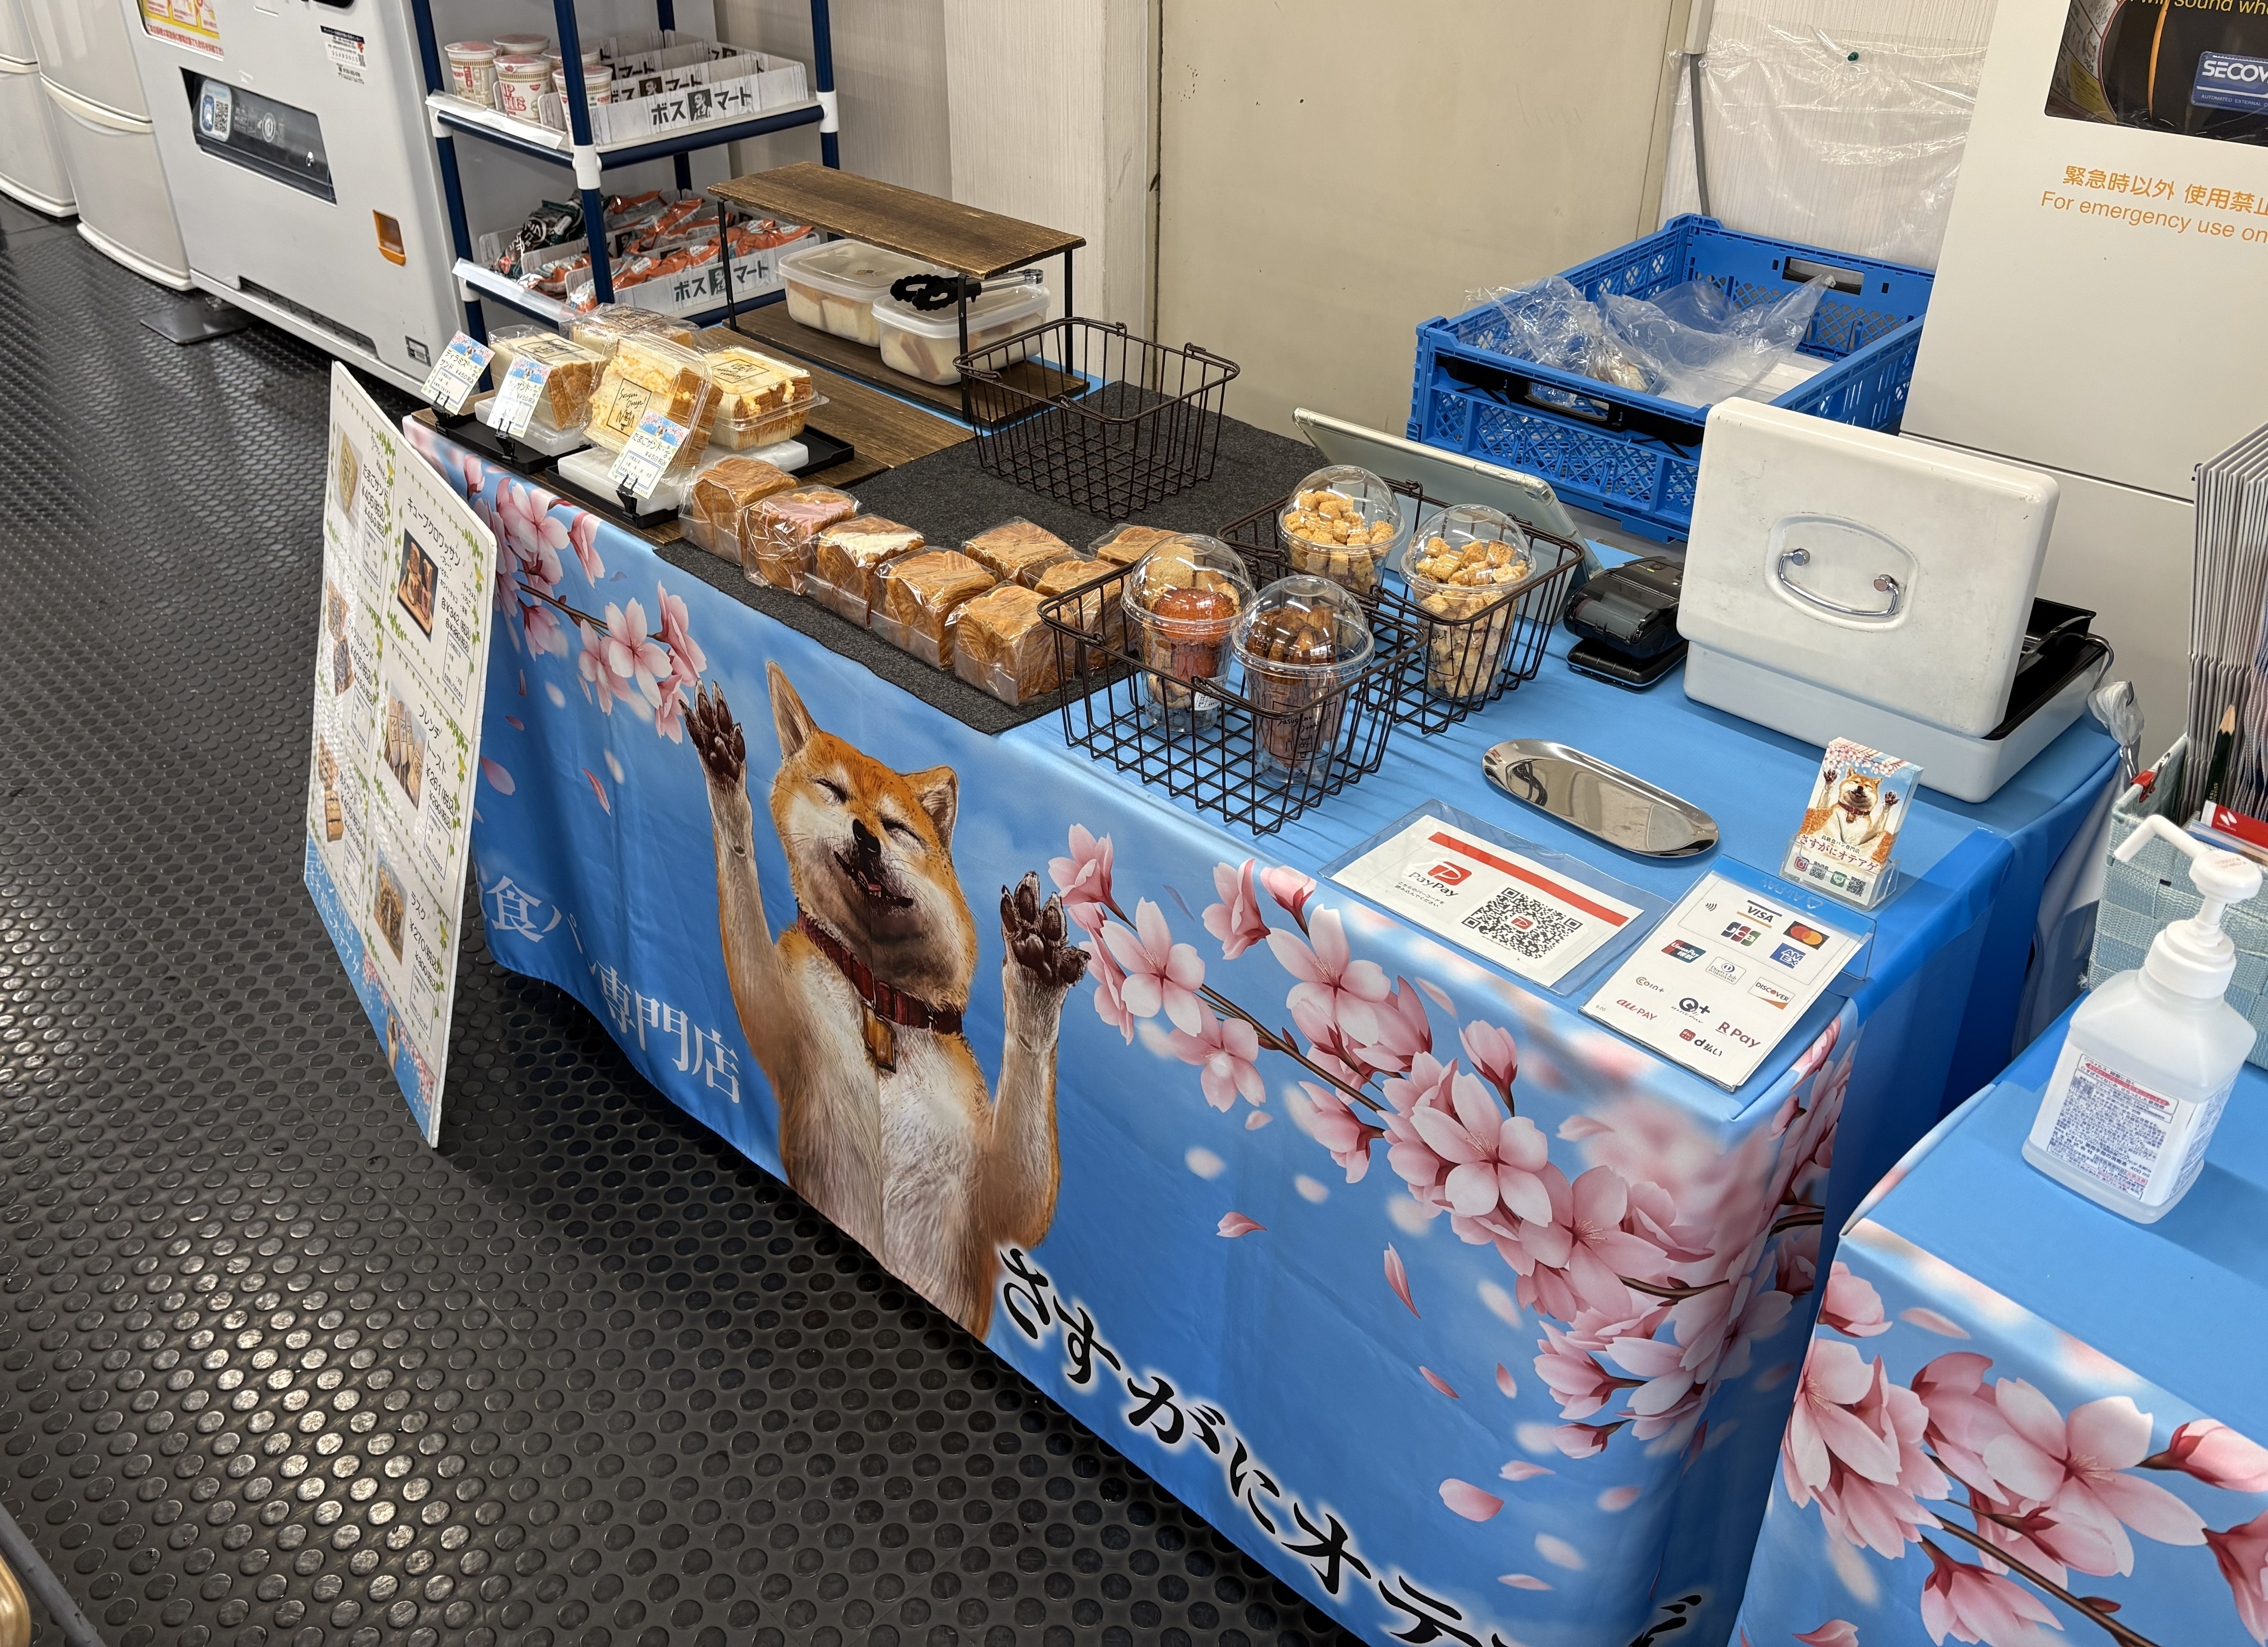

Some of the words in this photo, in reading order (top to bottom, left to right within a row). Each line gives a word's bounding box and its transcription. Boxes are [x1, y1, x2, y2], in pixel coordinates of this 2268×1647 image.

[2240, 0, 2268, 14] wh
[651, 100, 686, 125] ボス
[714, 86, 751, 110] マート
[2062, 165, 2175, 200] 緊急時以外
[2041, 190, 2074, 211] For
[2080, 197, 2191, 234] emergency
[2197, 221, 2235, 238] use
[674, 276, 707, 302] ボス
[733, 260, 768, 284] マート
[440, 359, 454, 370] サンド
[445, 350, 468, 368] ティラミス
[427, 739, 447, 776] トースト
[1799, 835, 1880, 871] さすがにオテアゲ
[1821, 835, 1861, 854] 高級食パン専門店
[1408, 871, 1459, 897] PayPay
[410, 888, 426, 927] ラスク
[1748, 905, 1774, 923] VISA
[1723, 925, 1757, 943] JCB
[1671, 942, 1700, 958] UnionPay
[1711, 965, 1725, 975] Diners
[1726, 972, 1737, 981] Club
[1755, 982, 1790, 1002] DISCOVER
[1617, 999, 1638, 1011] au
[1637, 1008, 1658, 1021] PAY
[1694, 1038, 1723, 1057] d払い
[1730, 1028, 1761, 1048] Pay
[2130, 1165, 2141, 1174] 400
[998, 1246, 1702, 1647] さすがにオテ
